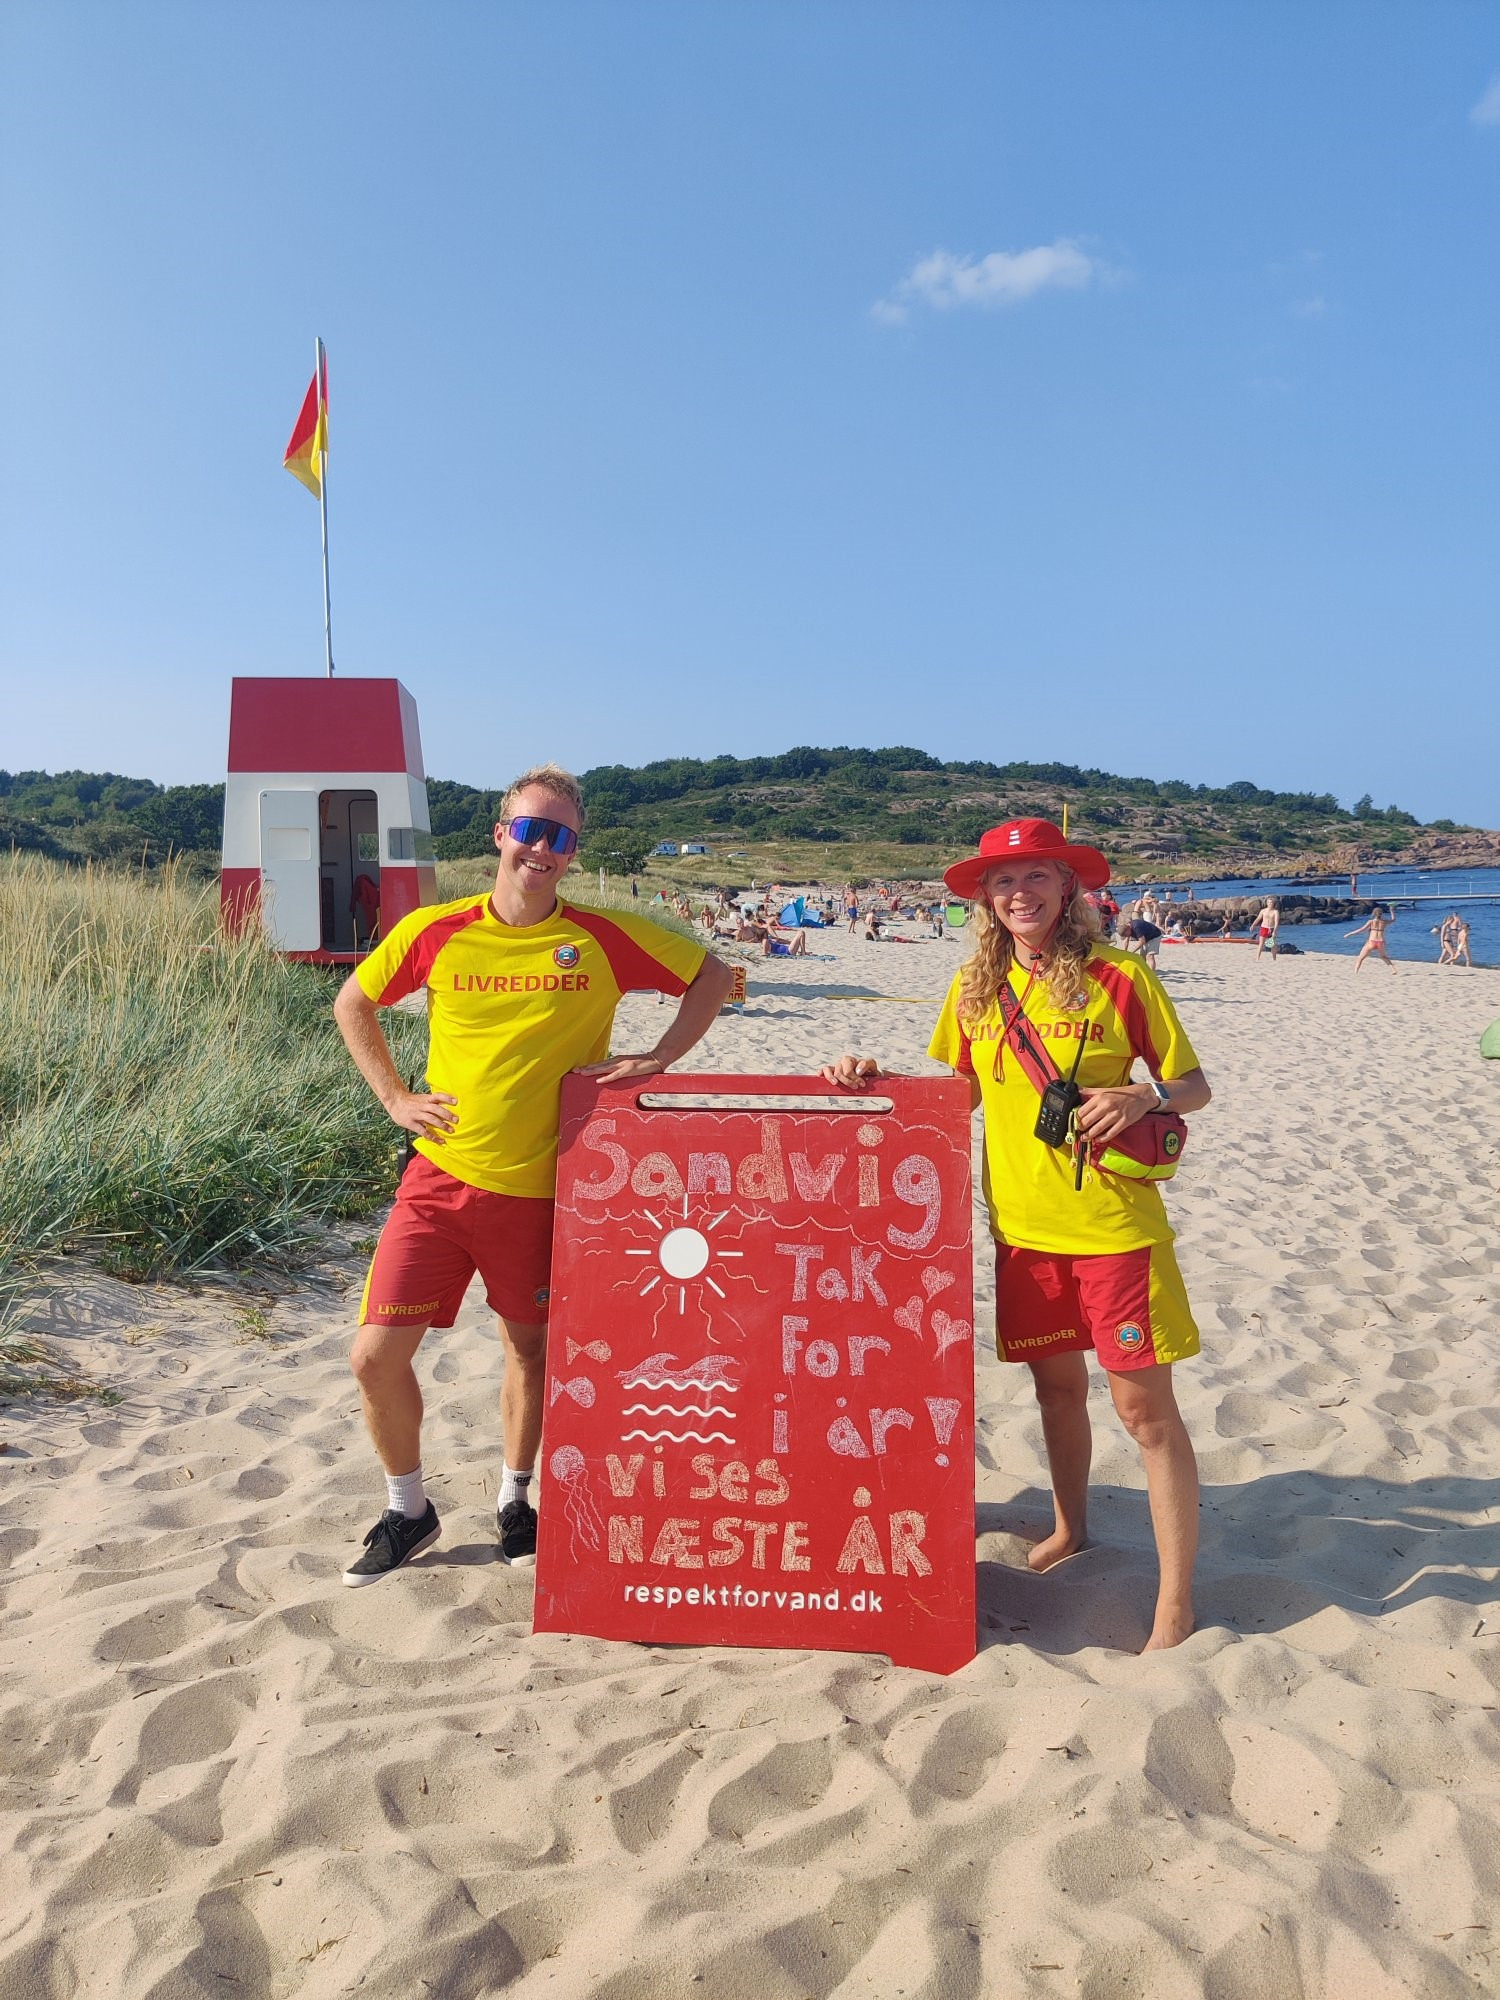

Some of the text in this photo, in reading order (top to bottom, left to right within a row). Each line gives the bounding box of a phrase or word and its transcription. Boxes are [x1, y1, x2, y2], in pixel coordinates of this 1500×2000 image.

[453, 974, 590, 993] LIVREDDER
[970, 1021, 1105, 1043] LIVDDER
[572, 1118, 941, 1249] Sandvig
[378, 1301, 440, 1315] LIVREDDER
[782, 1315, 891, 1378] For
[1007, 1329, 1077, 1350] LIVREDDER
[773, 1392, 788, 1453] i
[607, 1486, 933, 1578] NÆSTE ÅR
[624, 1583, 884, 1613] respektforvand.dk
